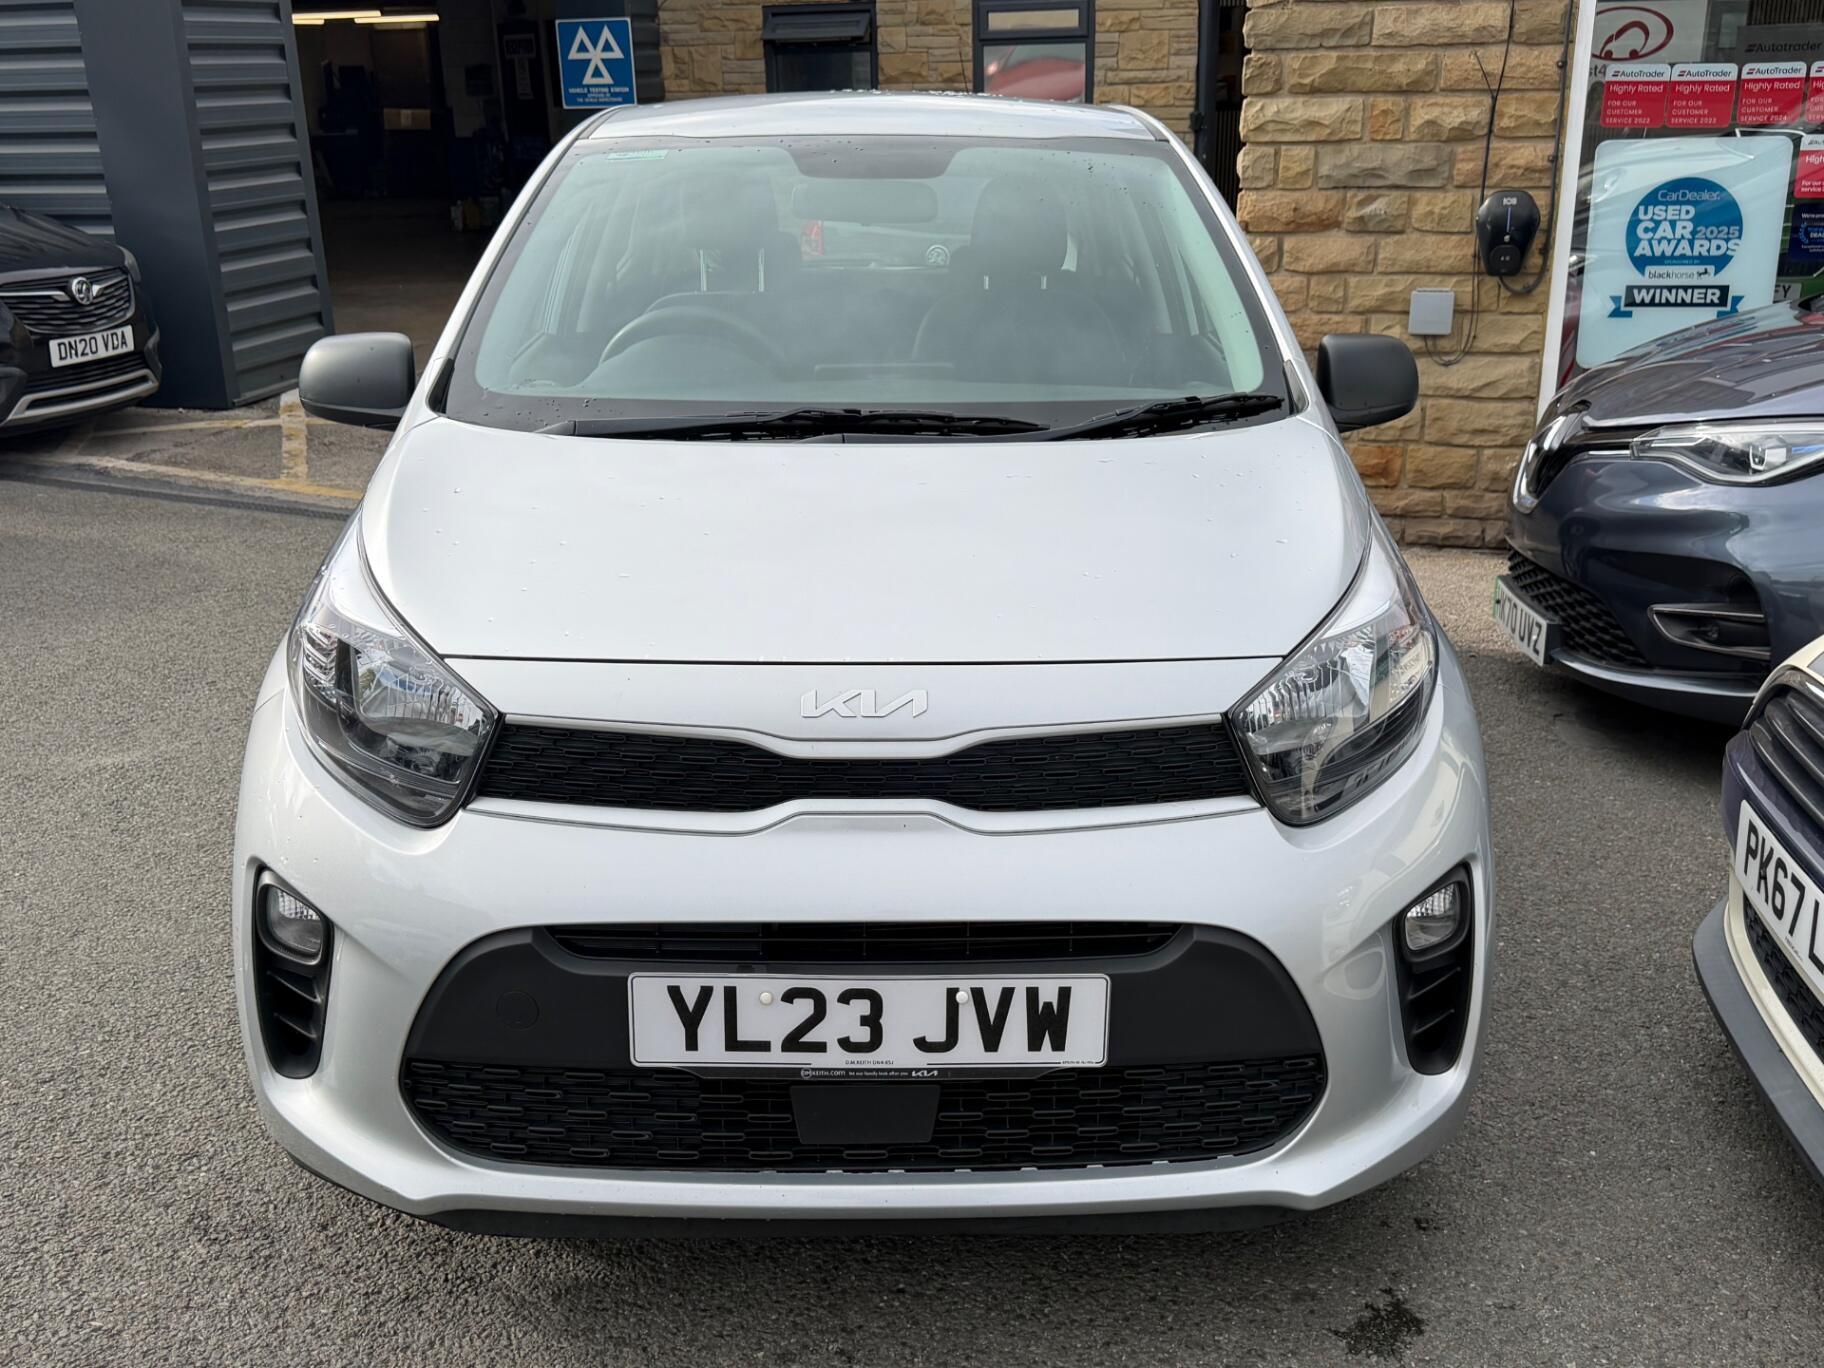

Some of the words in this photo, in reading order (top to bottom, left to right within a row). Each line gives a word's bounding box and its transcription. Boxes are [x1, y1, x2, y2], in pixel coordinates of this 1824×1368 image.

[1756, 41, 1822, 53] Autotrader
[1620, 69, 1665, 78] AutoTrader
[1685, 69, 1732, 78] AutoTrader
[1755, 66, 1802, 76] AutoTrader
[1609, 84, 1637, 94] Highly
[1637, 83, 1664, 93] Rated
[1675, 83, 1702, 94] Highly
[1703, 83, 1730, 93] Rated
[1744, 81, 1773, 92] Highly
[1773, 80, 1801, 90] Rated
[1638, 205, 1696, 220] USED
[1636, 220, 1694, 239] CAR
[1695, 226, 1739, 239] 2025
[1633, 239, 1741, 257] AWARDS
[1648, 270, 1695, 280] blackhorse
[1633, 288, 1720, 304] WINNER
[57, 336, 98, 361] DN20
[101, 330, 129, 352] VDA
[1518, 607, 1542, 656] UVZ
[1744, 818, 1806, 937] PK67
[667, 985, 884, 1054] YL23
[912, 986, 1072, 1054] JVW
